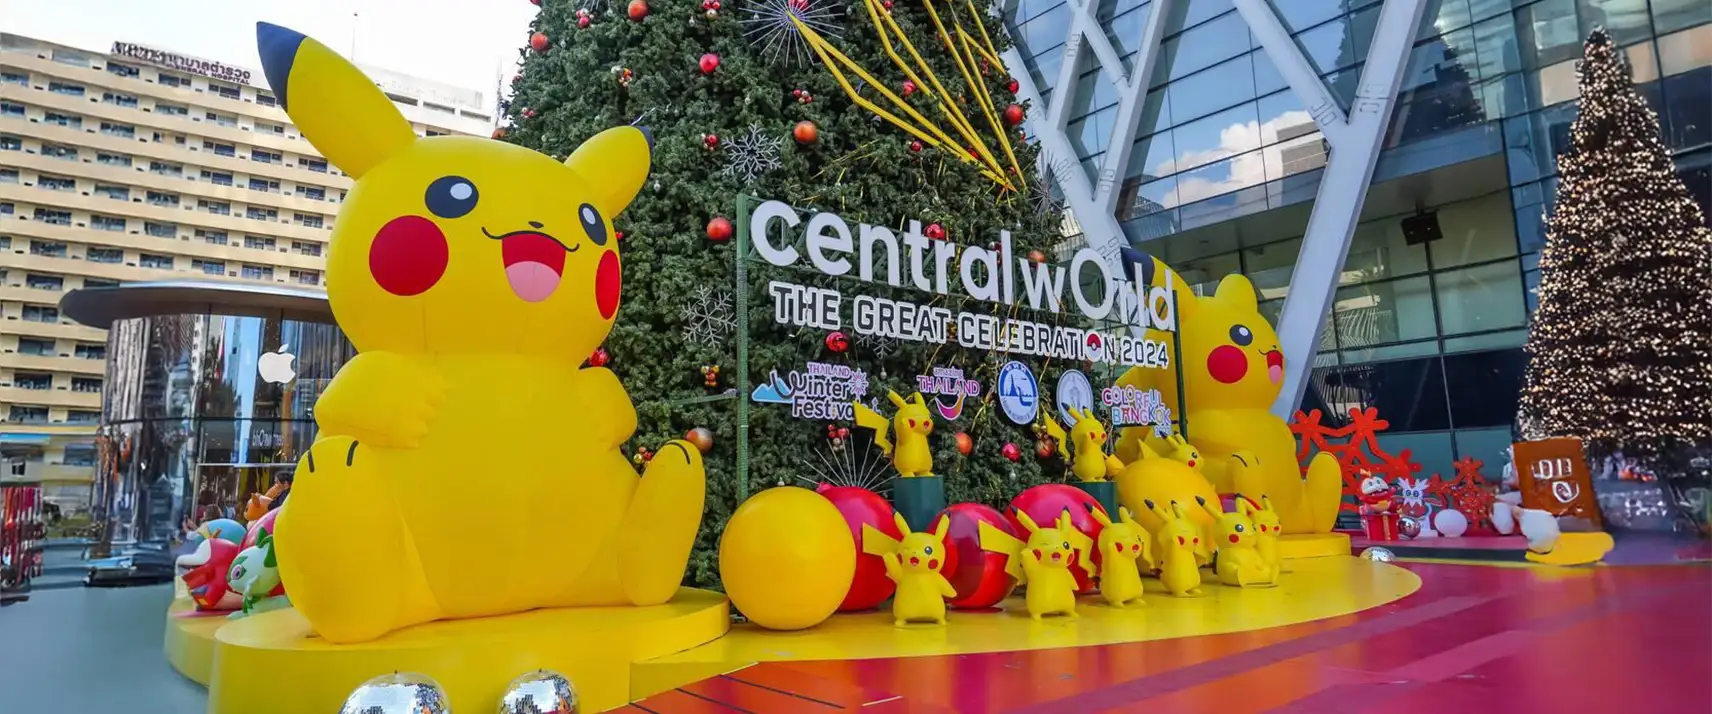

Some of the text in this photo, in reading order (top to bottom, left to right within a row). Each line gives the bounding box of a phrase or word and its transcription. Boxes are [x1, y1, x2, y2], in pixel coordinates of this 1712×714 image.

[771, 282, 841, 329] THE
[854, 297, 949, 343] GREAT
[1121, 338, 1168, 368] 2024
[807, 362, 850, 378] THAILAND
[770, 370, 850, 400] Winter
[917, 375, 979, 396] THAILAND
[1102, 385, 1164, 408] COLORFUL
[793, 396, 855, 419] Festiva
[1111, 406, 1171, 425] BANGKOK
